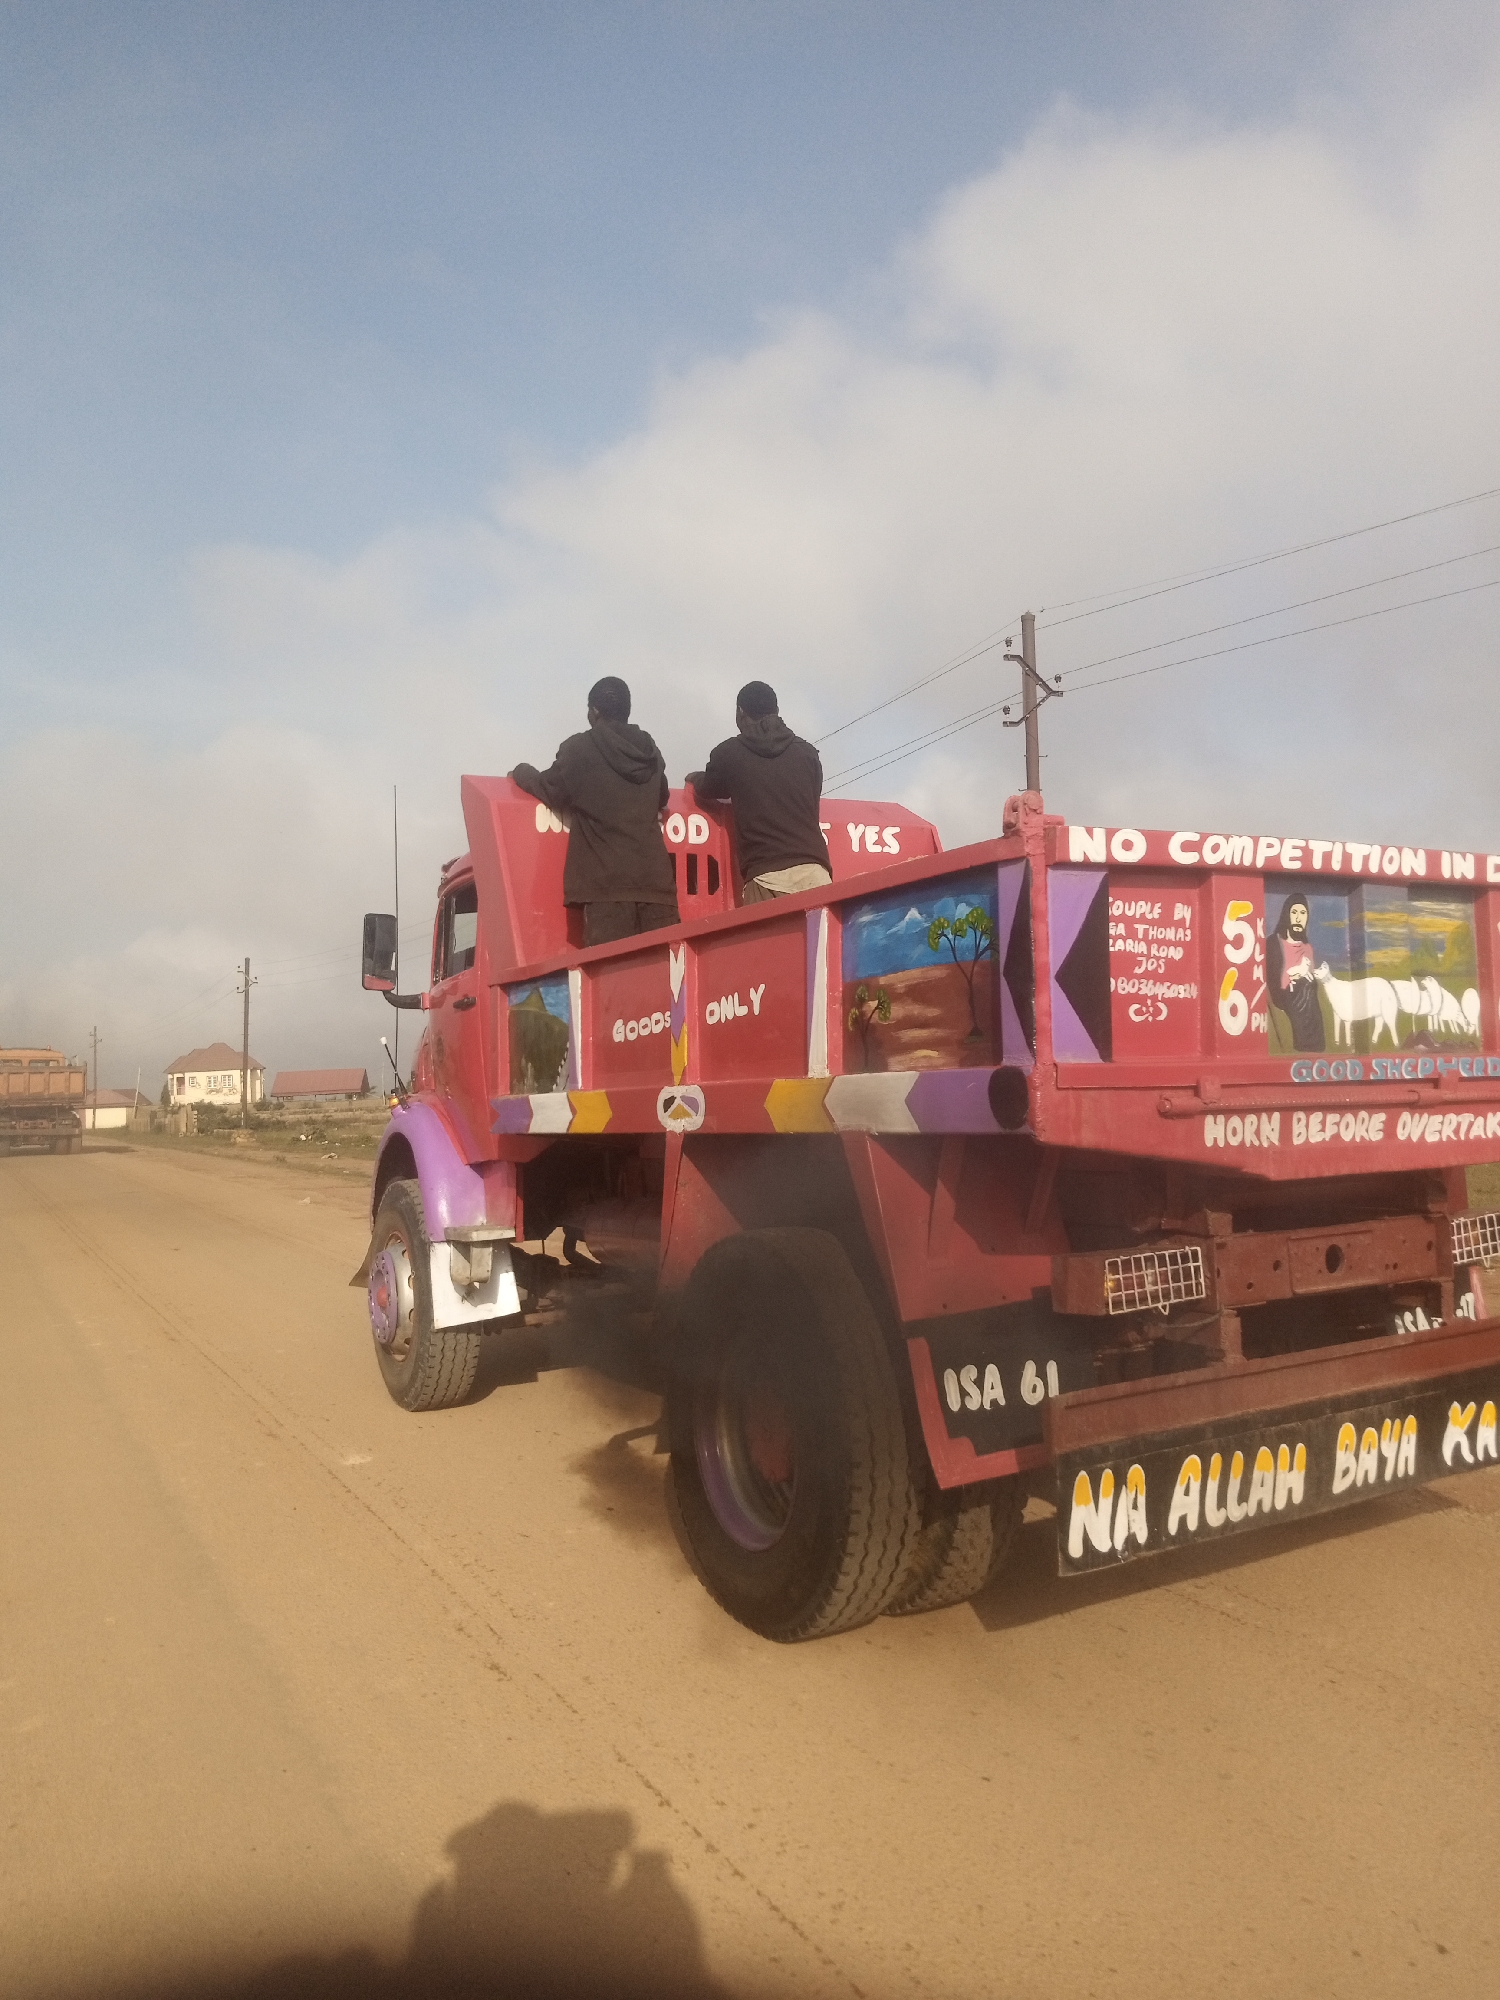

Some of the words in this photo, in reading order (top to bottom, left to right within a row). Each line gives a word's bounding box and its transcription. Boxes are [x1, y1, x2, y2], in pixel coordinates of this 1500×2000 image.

[657, 811, 710, 845] OD
[846, 822, 901, 855] YES
[1068, 825, 1147, 864] NO
[1168, 831, 1427, 877] COMPETITION
[1441, 851, 1475, 879] IN
[1133, 923, 1192, 942] THOMAS
[1173, 902, 1192, 928] BY
[1133, 956, 1165, 974] JOS
[1150, 943, 1184, 961] ROAD
[612, 1010, 671, 1043] GOODS
[706, 983, 766, 1025] ONLY
[1290, 1059, 1364, 1083] GOOD
[1204, 1111, 1281, 1148] HORN
[1292, 1110, 1386, 1146] BEFORE
[1396, 1111, 1500, 1143] OVERTAK
[943, 1363, 1006, 1412] ISA
[1020, 1360, 1060, 1406] 61
[1068, 1463, 1149, 1559] NA
[1167, 1442, 1307, 1536] ALLAH
[1332, 1414, 1418, 1495] BAYA
[1441, 1400, 1498, 1467] KA
